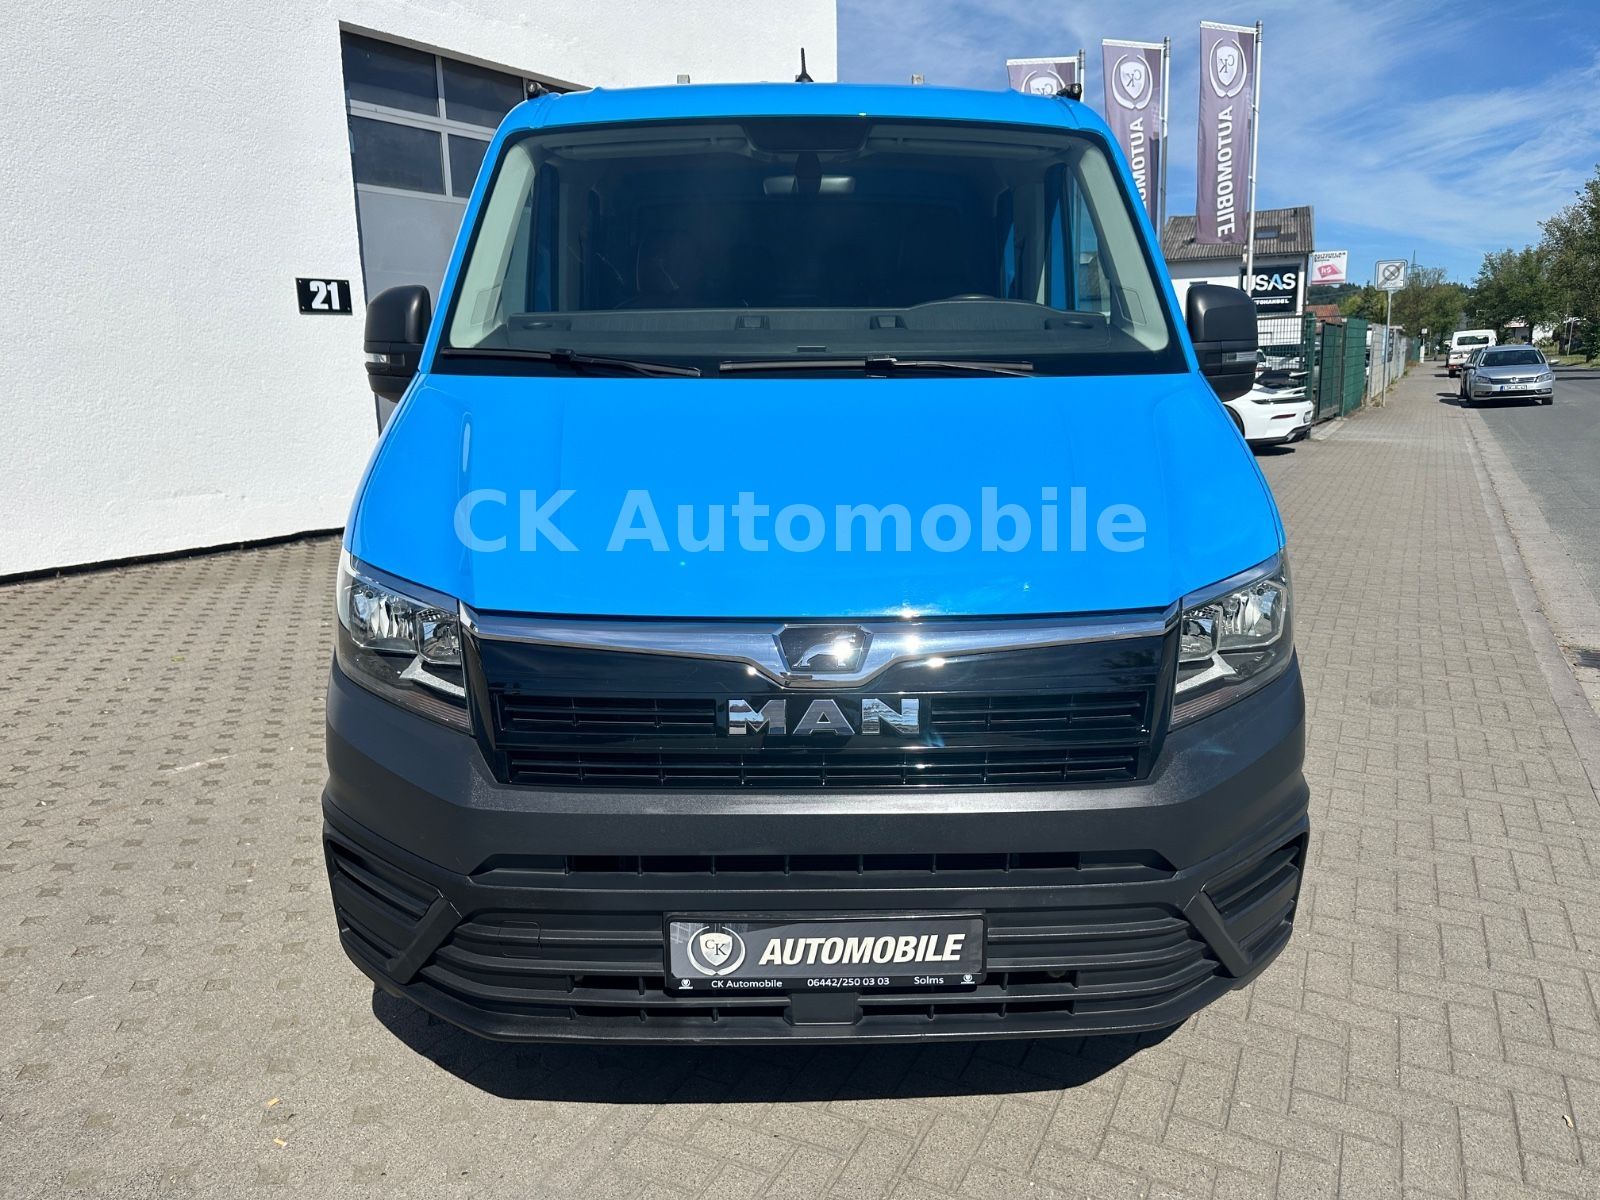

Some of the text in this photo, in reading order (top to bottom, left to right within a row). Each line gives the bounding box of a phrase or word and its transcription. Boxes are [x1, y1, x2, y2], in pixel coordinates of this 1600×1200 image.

[309, 280, 340, 310] 21
[1242, 273, 1296, 291] USAS
[728, 698, 920, 735] MAN
[704, 931, 966, 965] CK AUTOMOBILE
[711, 975, 944, 989] CK Automobile 06442/250 03 03 Solms
